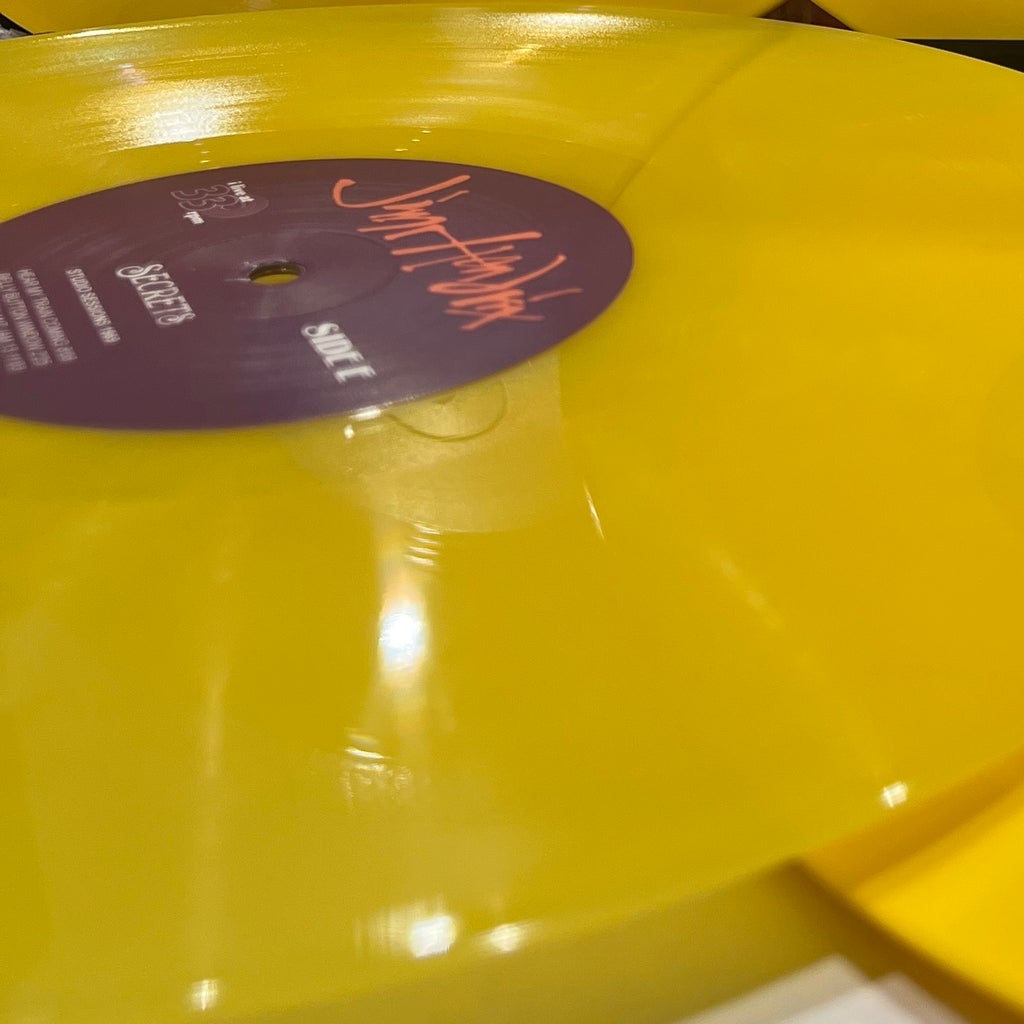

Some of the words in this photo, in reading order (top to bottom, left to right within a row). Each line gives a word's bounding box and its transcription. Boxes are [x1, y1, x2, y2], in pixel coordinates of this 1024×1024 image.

[65, 268, 93, 293] STUDIO
[80, 292, 111, 327] SESSIONS
[115, 263, 197, 327] SECRETS
[301, 322, 365, 367] SIDE
